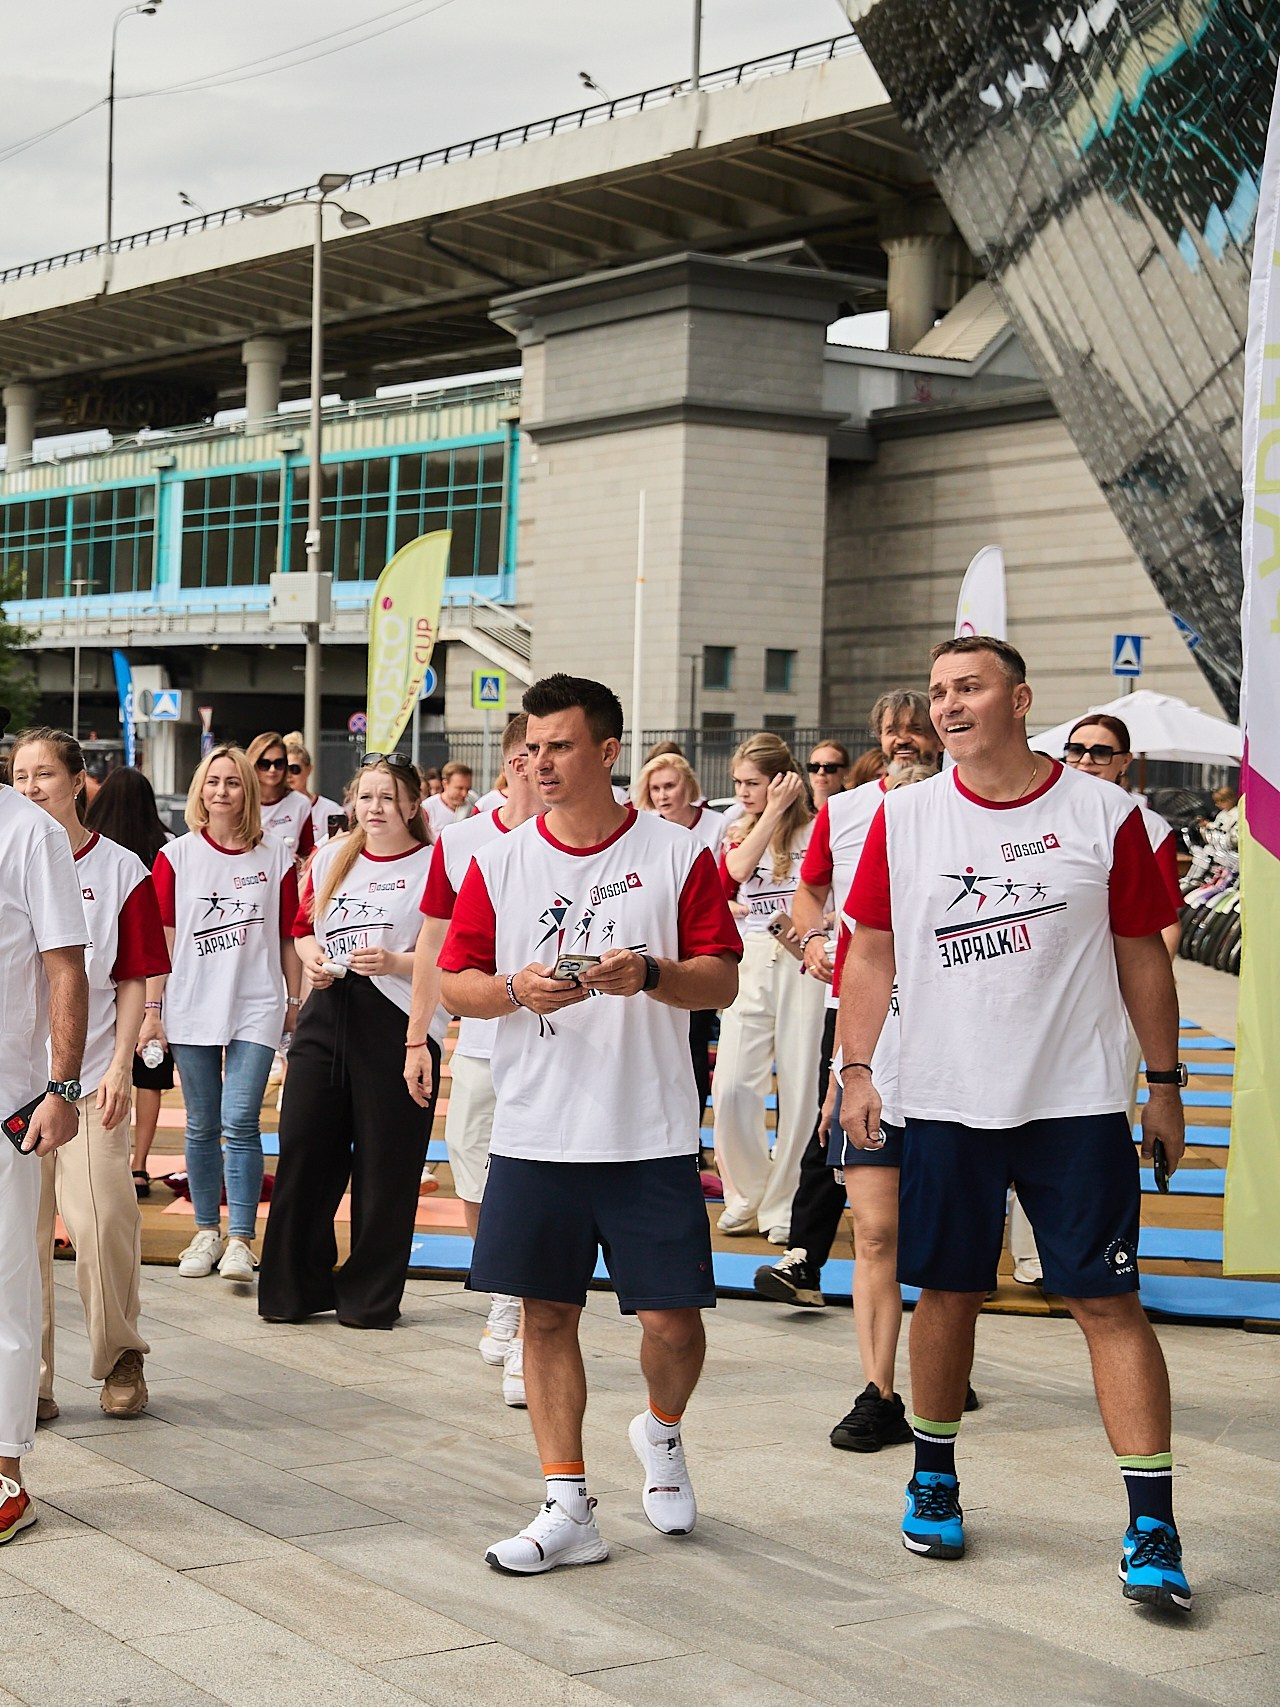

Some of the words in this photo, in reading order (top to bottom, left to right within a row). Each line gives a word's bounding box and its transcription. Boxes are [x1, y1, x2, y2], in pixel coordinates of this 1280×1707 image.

[415, 618, 433, 664] CUP
[195, 927, 247, 957] ЗАРЯДКА
[938, 923, 1032, 968] ЗАРЯДКА
